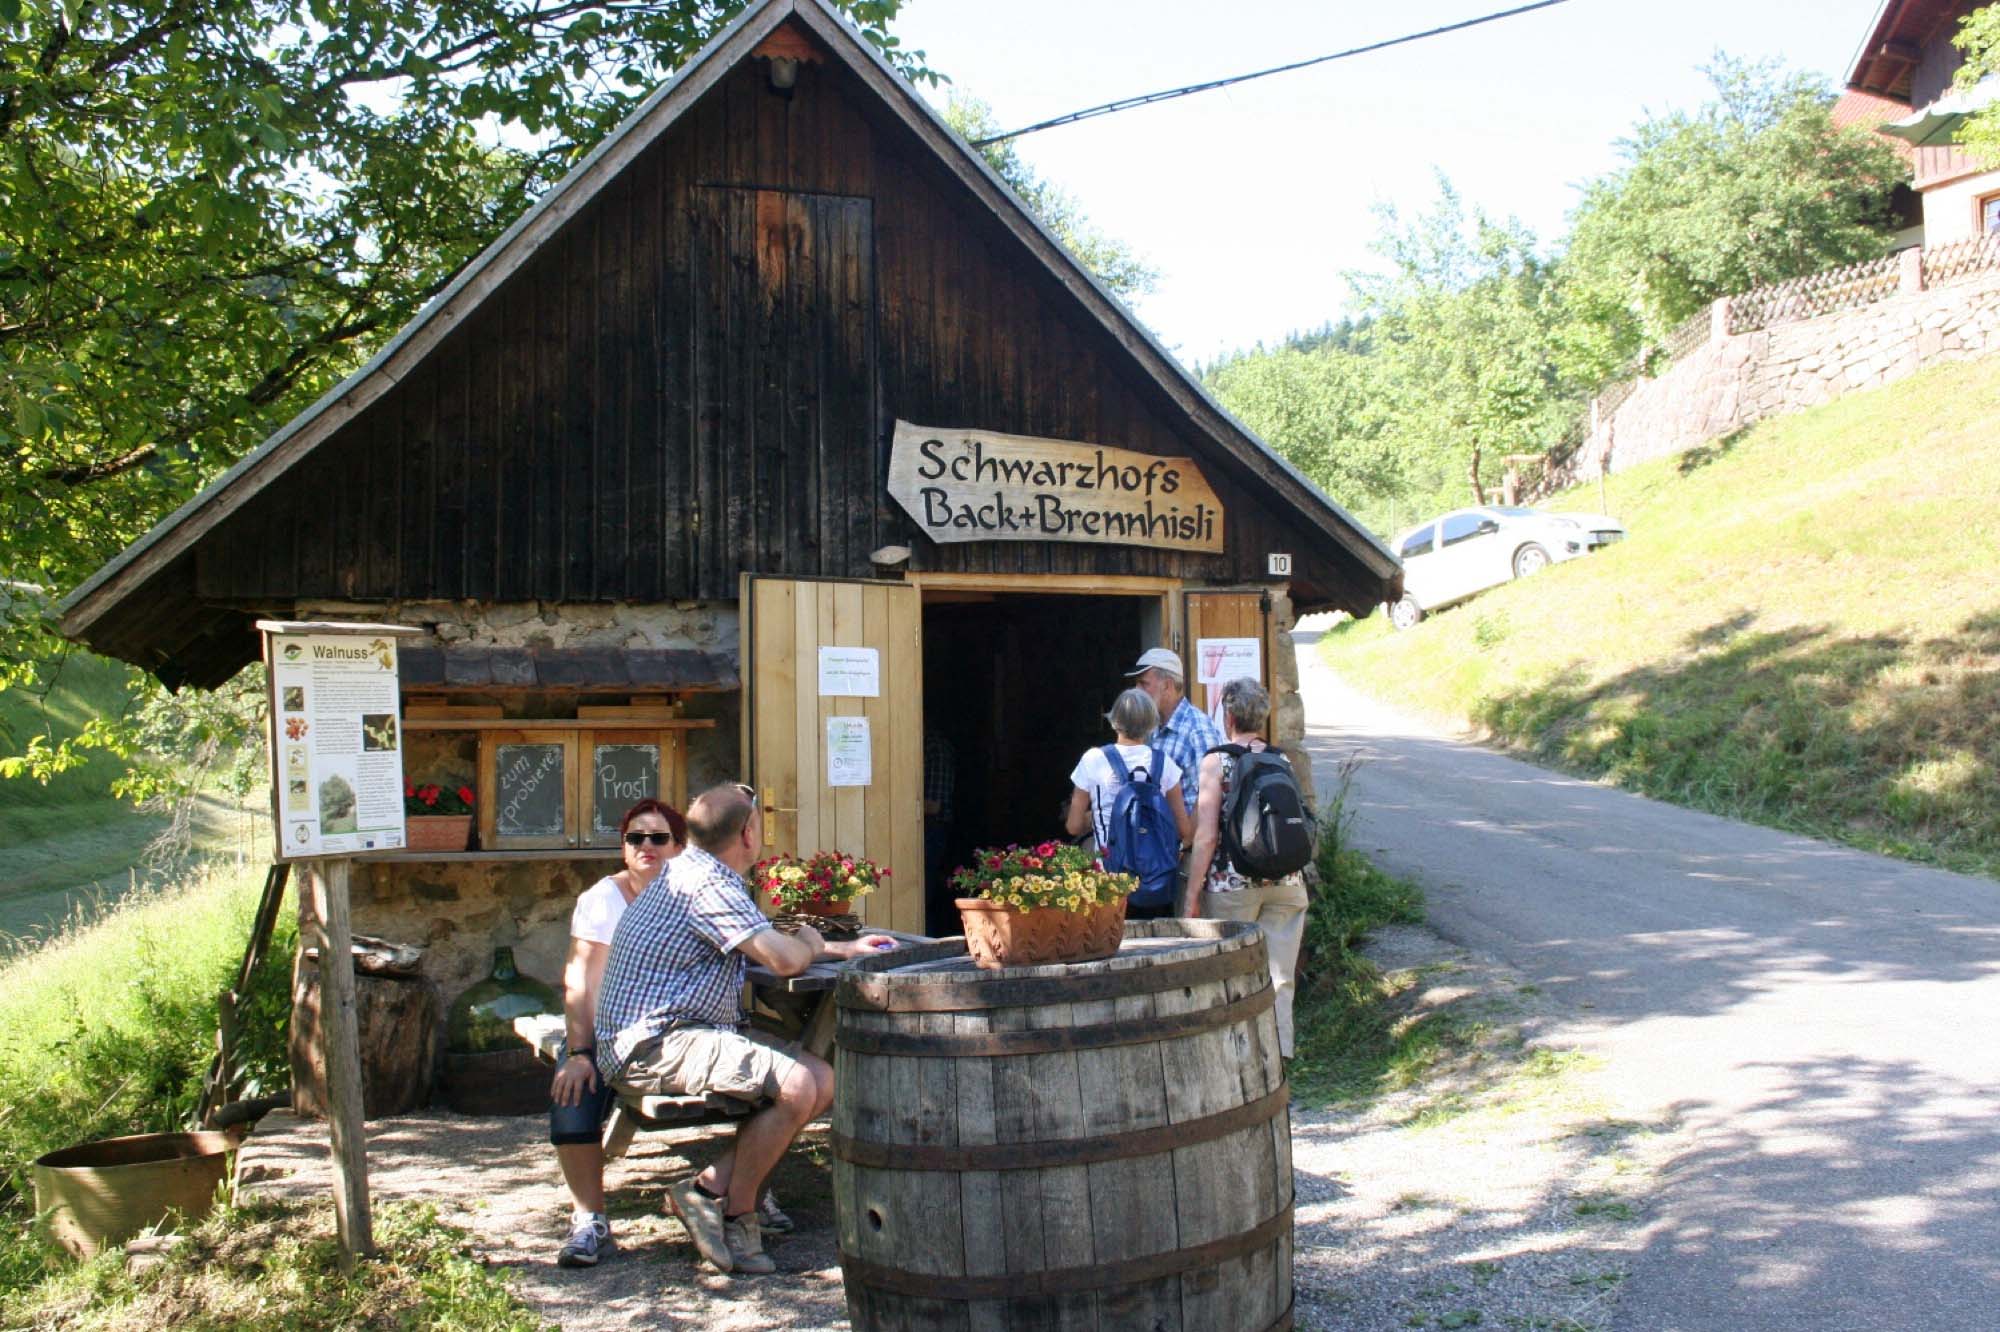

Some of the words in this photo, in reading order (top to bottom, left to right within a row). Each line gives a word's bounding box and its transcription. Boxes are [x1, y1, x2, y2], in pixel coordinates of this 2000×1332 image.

[917, 439, 1181, 496] Schwarzhofs
[1273, 557, 1287, 571] 10
[313, 646, 369, 659] Walnuss
[500, 755, 531, 790] zum
[598, 764, 649, 800] Prost
